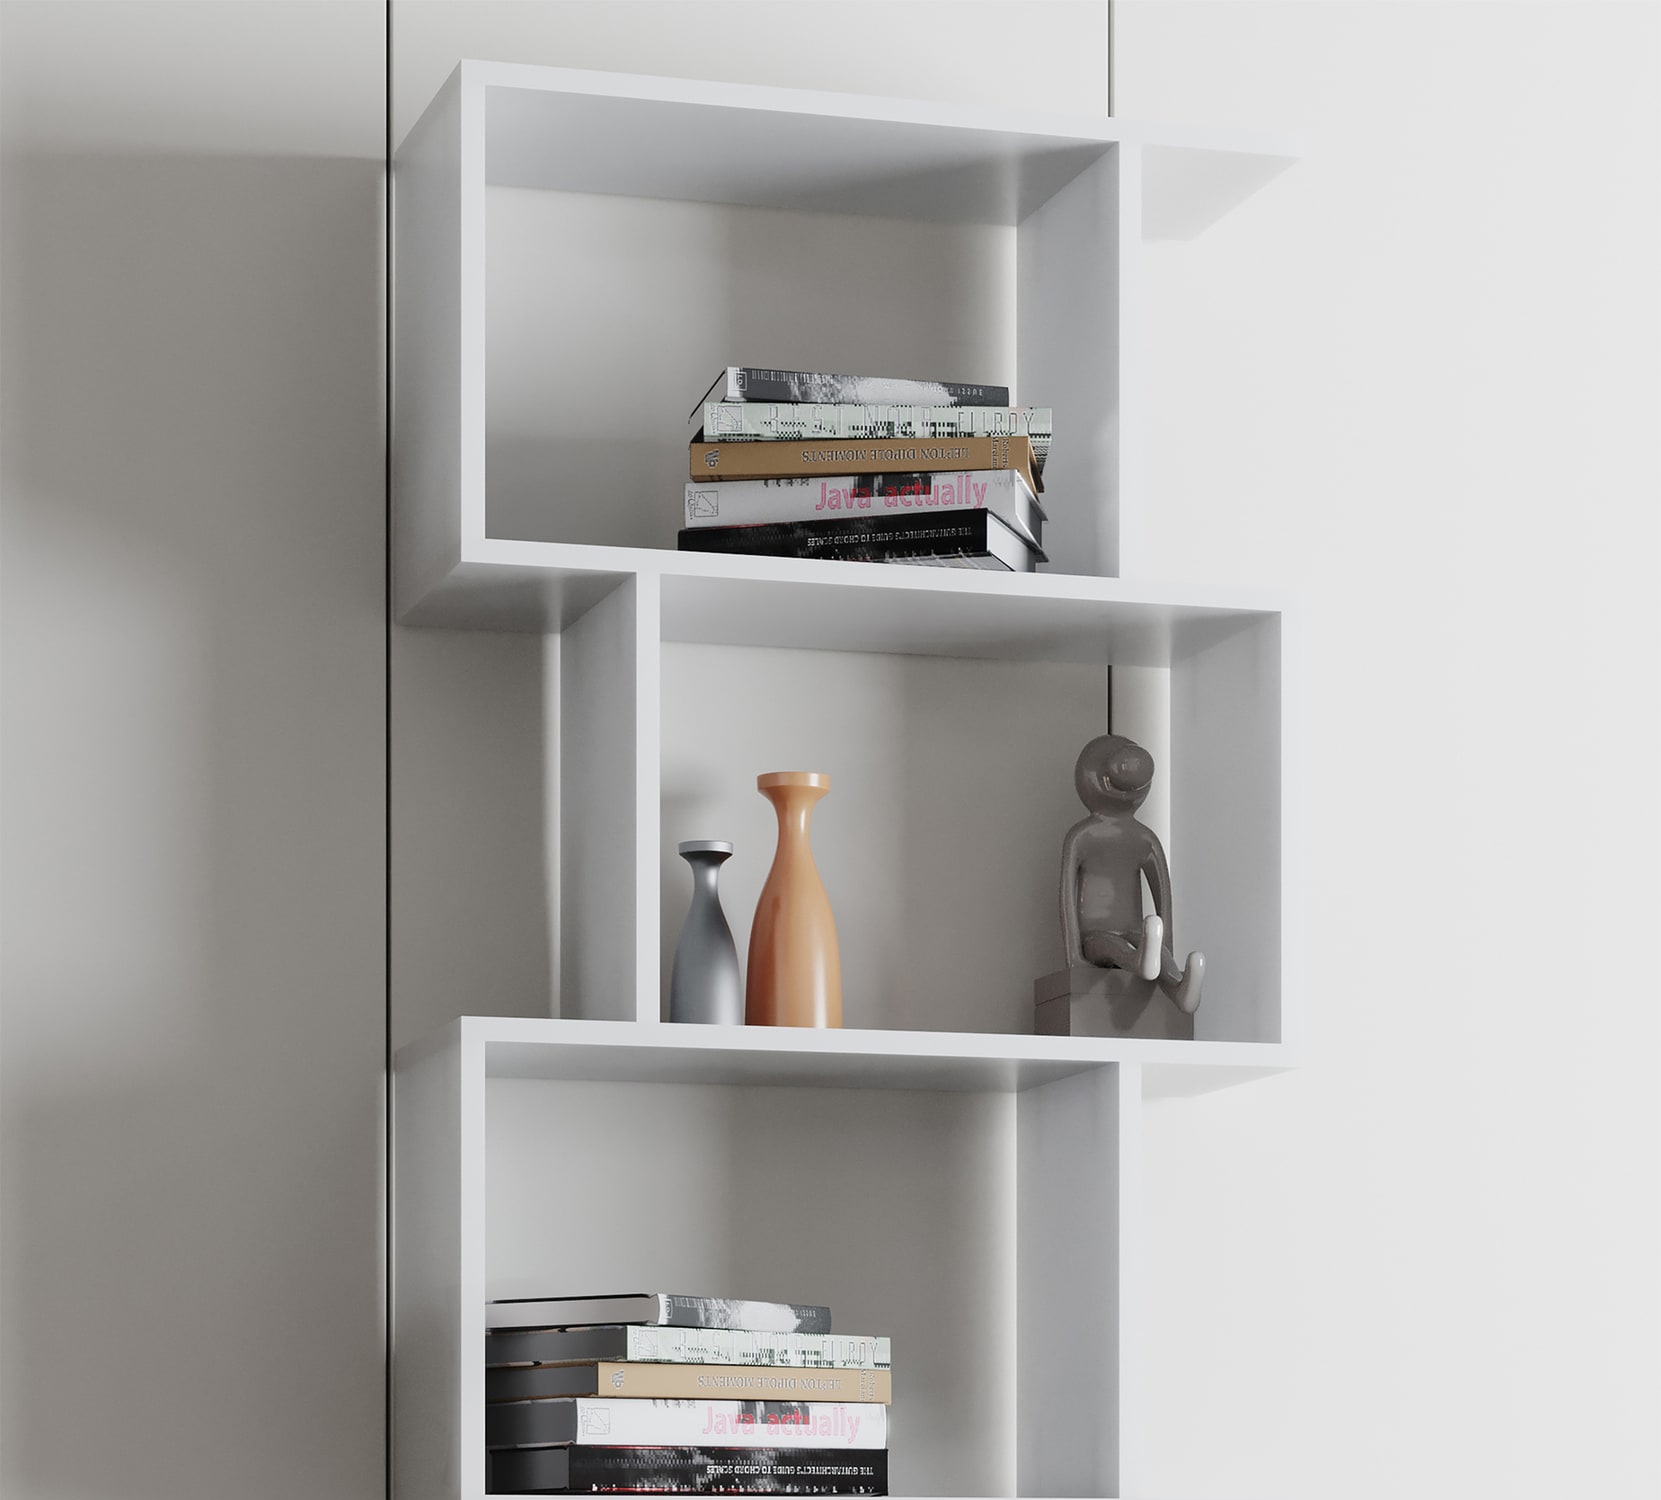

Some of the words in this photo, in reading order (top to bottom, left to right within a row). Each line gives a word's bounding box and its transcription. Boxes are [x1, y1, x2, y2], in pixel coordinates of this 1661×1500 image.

[801, 450, 866, 463] MOMENTS
[871, 449, 916, 461] DIPOLE
[920, 447, 970, 460] LEPTON
[815, 481, 872, 511] Java
[883, 474, 988, 509] actually
[861, 533, 871, 543] TO
[697, 1375, 755, 1389] MOMENTS
[757, 1377, 797, 1390] DIPOLE
[799, 1379, 842, 1391] LEPTON
[702, 1406, 755, 1435] Java
[767, 1407, 861, 1444] actually
[706, 1464, 734, 1475] SCALES
[734, 1465, 761, 1475] CHORD
[761, 1465, 772, 1475] TO
[773, 1465, 796, 1475] GUIDE
